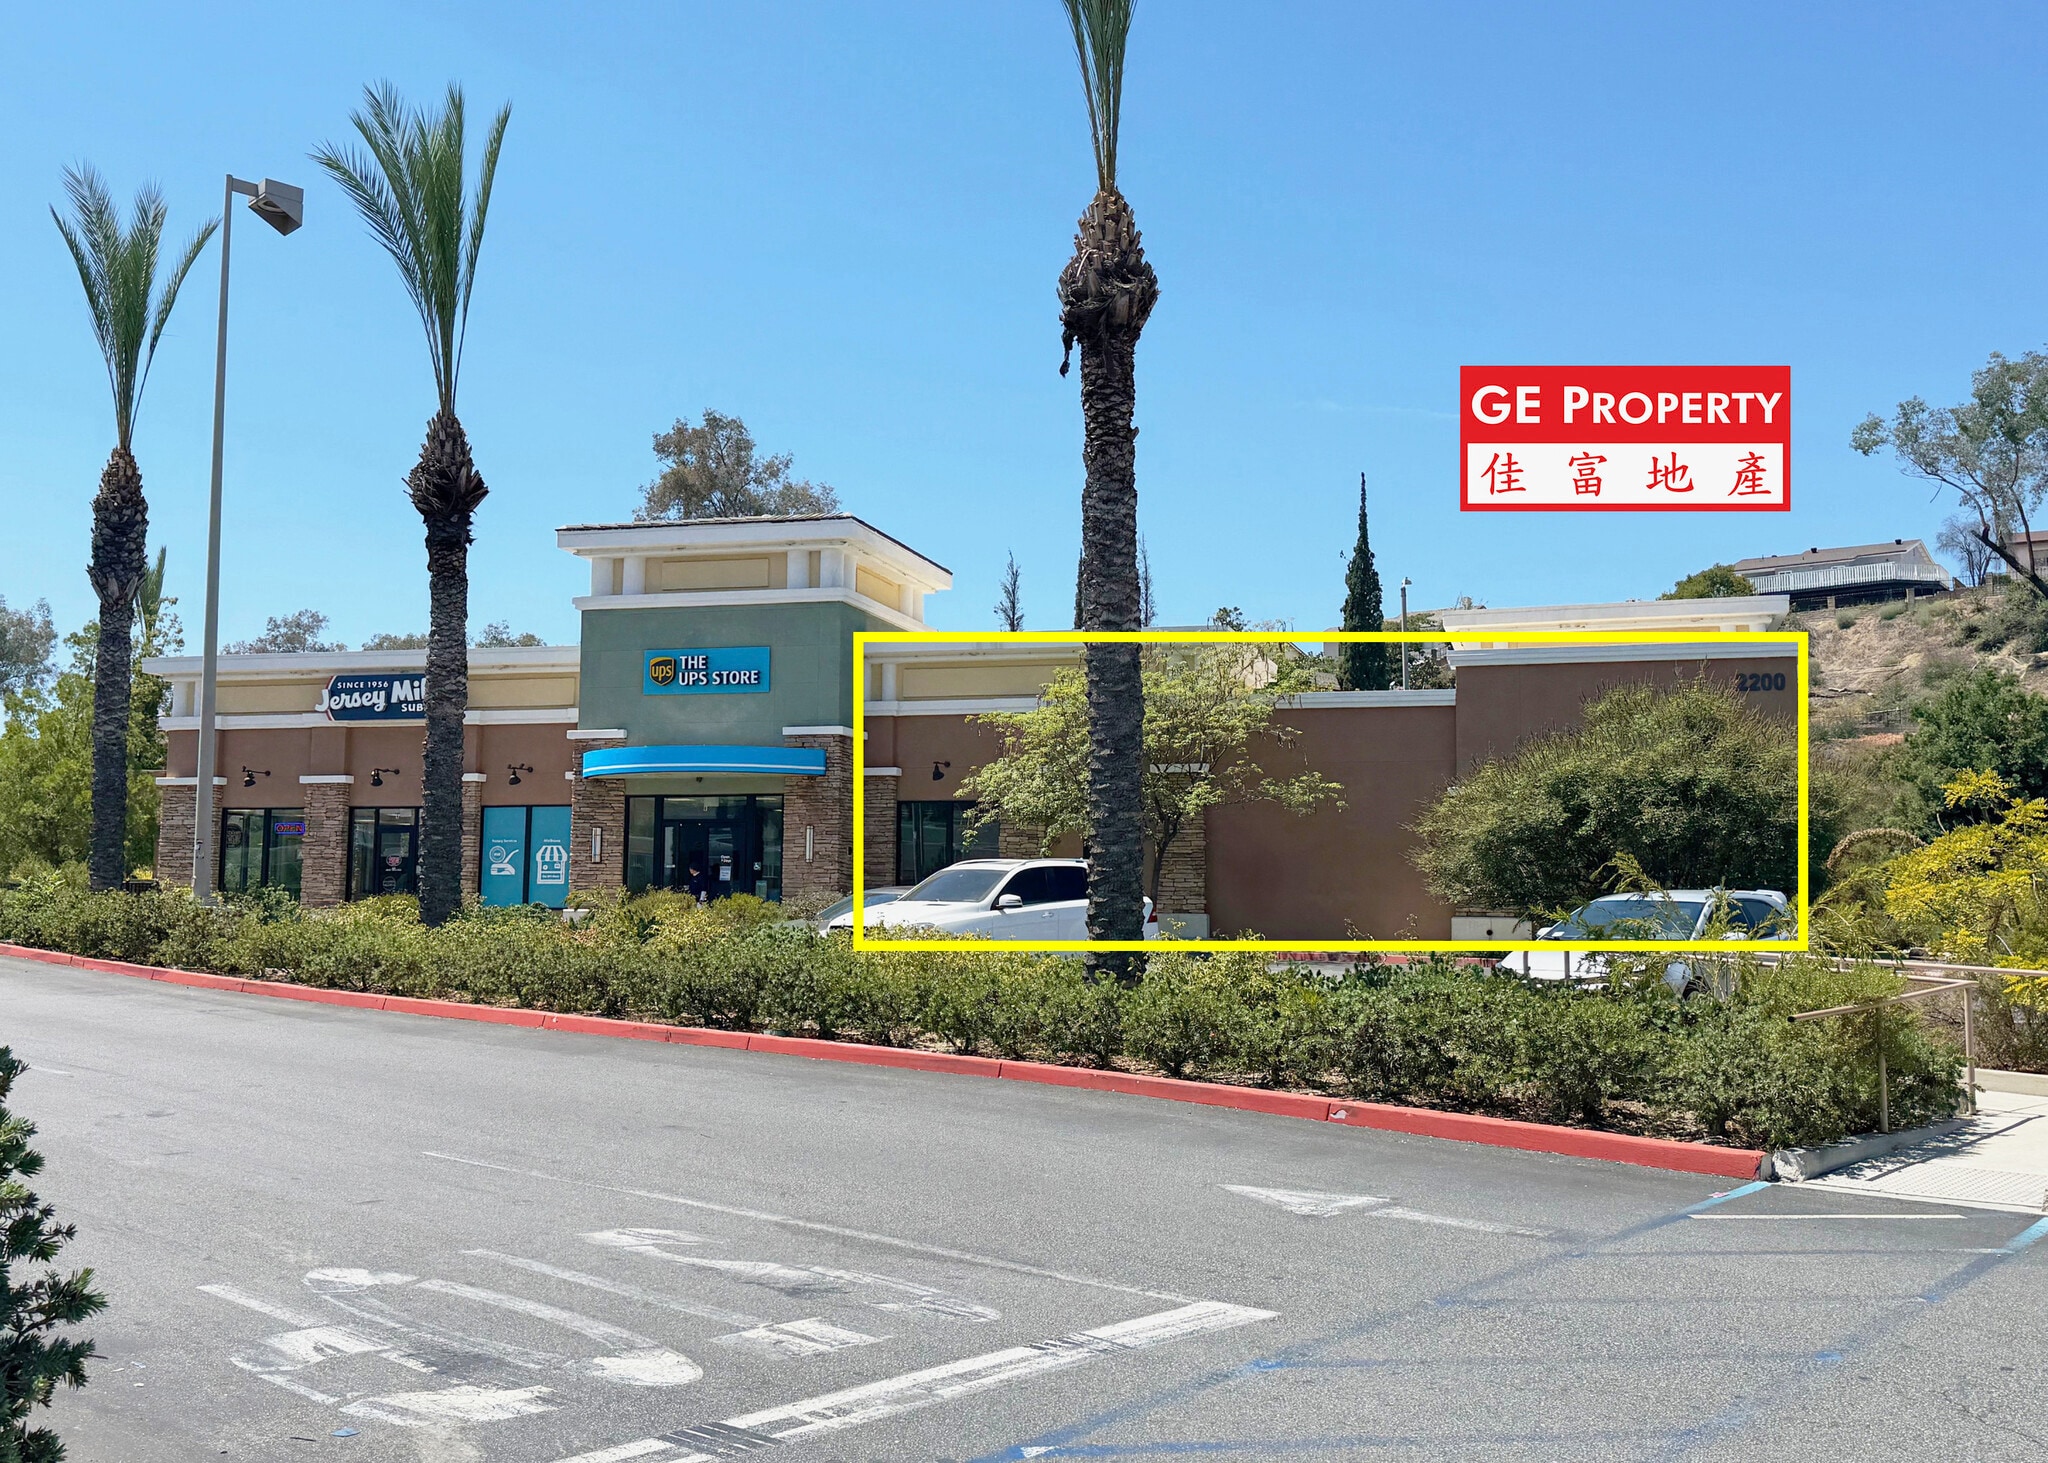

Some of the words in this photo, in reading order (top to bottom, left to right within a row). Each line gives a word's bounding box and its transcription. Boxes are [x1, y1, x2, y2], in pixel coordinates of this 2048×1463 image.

[679, 655, 707, 670] THE
[337, 681, 364, 689] SINCE
[678, 671, 708, 686] UPS
[711, 670, 759, 685] STORE
[1736, 672, 1786, 692] 2200
[314, 688, 387, 712] Jersey
[401, 703, 427, 712] SUB
[276, 824, 303, 832] OPEN
